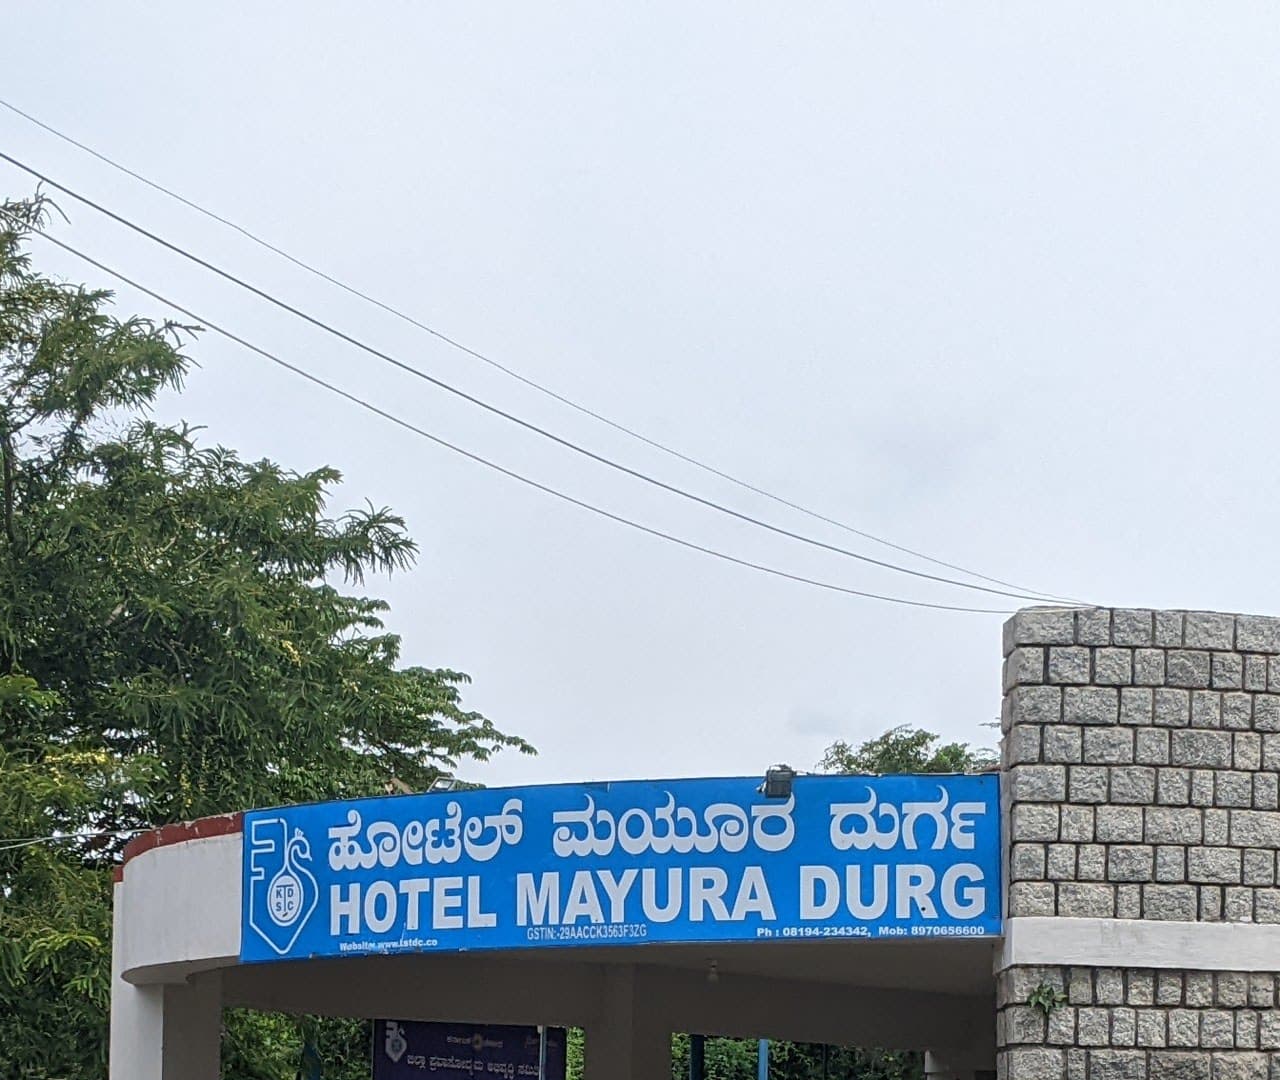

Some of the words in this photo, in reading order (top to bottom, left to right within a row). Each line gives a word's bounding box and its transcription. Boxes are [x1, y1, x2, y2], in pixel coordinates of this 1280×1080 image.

[328, 799, 523, 871] ಹೋಟೆಲ್
[552, 790, 796, 857] ಮಯೂರ
[829, 785, 987, 850] ದುರ್ಗ
[330, 875, 497, 936] HOTEL
[516, 866, 777, 926] MAYURA
[799, 863, 986, 920] DURG
[878, 926, 908, 936] Mob:
